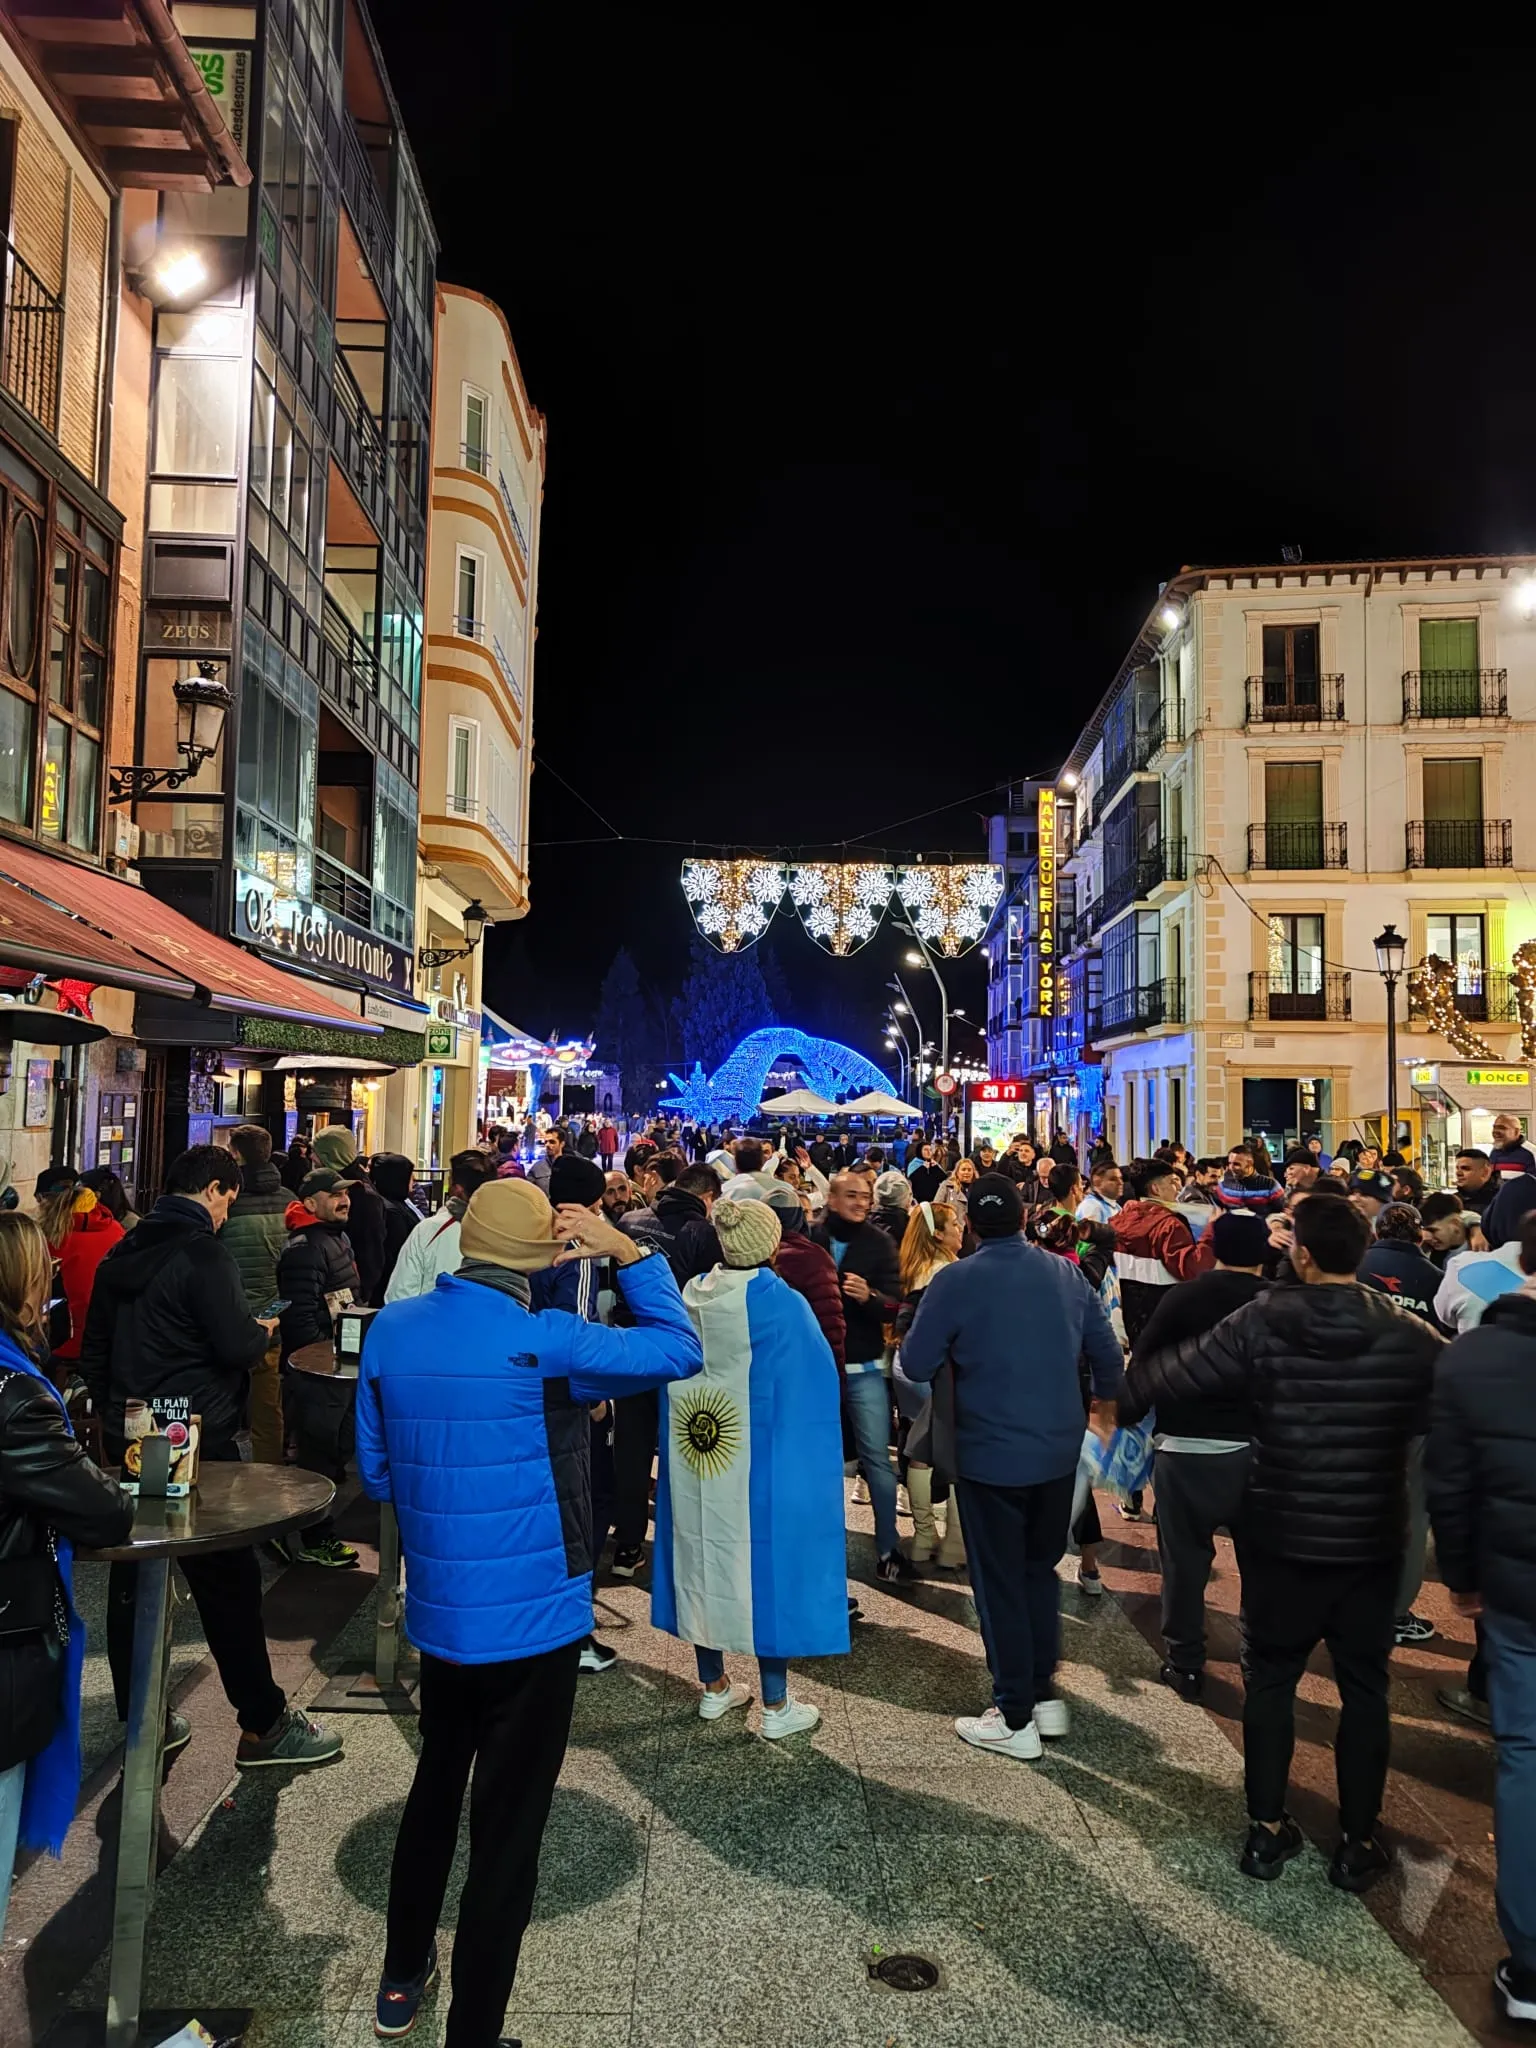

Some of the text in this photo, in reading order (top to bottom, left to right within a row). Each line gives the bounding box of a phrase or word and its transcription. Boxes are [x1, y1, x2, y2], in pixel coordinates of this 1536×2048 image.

[161, 624, 210, 639] ZEUS
[1040, 791, 1053, 1016] MANTEQUERIAS YORK
[244, 888, 274, 938] Olé
[291, 910, 393, 982] restaurante
[1485, 1073, 1524, 1083] ONCE
[982, 1085, 998, 1098] 20
[1390, 1294, 1429, 1313] ORA
[152, 1398, 162, 1408] EL
[166, 1408, 188, 1421] OLLA
